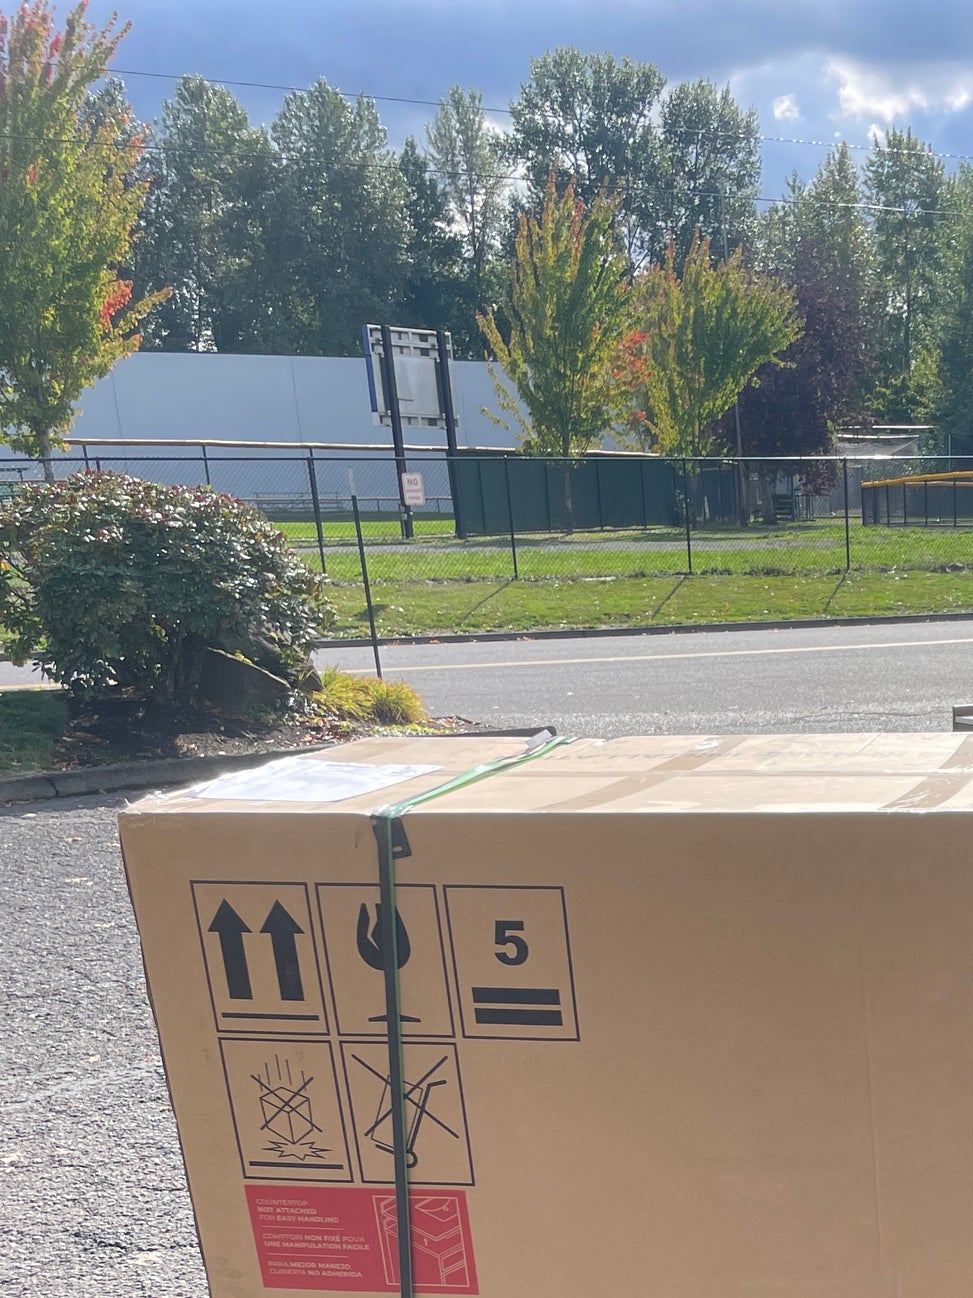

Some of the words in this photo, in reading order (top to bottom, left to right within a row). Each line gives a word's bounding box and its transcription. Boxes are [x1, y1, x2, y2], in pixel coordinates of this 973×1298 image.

[494, 919, 529, 966] 5
[256, 1198, 308, 1206] COUNTERTOP
[275, 1207, 317, 1215] ATTACHED
[276, 1214, 297, 1222] EASY
[262, 1232, 303, 1240] COMPTOIR
[282, 1241, 341, 1250] MANIPULATION
[343, 1243, 370, 1251] FACILE
[290, 1261, 317, 1269] MEJOR
[321, 1270, 363, 1278] ADHERIDA
